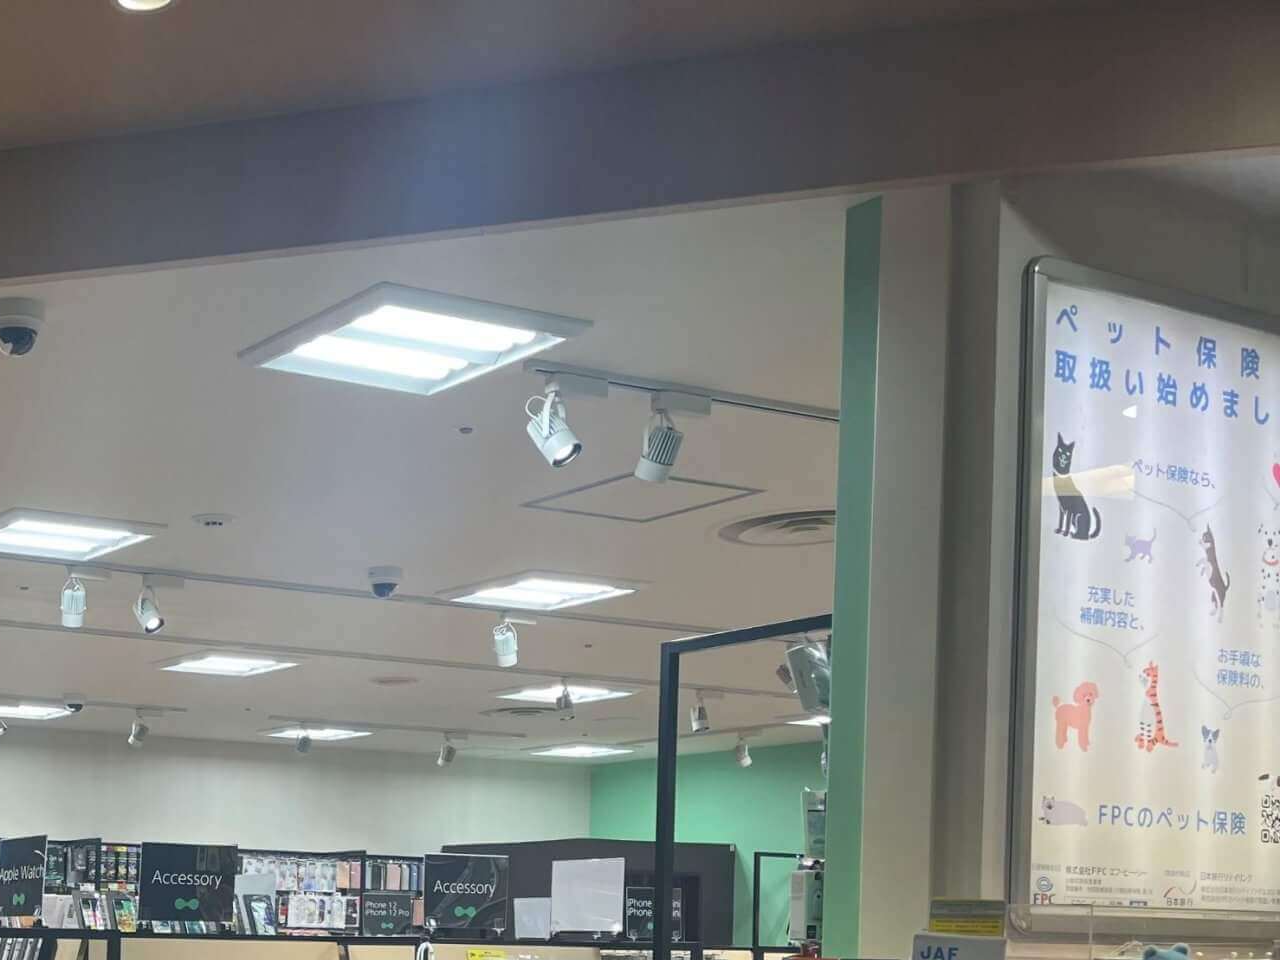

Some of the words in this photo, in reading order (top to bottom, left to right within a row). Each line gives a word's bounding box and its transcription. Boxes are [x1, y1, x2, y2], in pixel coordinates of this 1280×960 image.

[1056, 304, 1260, 379] ペット保険
[1087, 585, 1136, 608] 充実した
[1098, 805, 1247, 836] FPCのペット保険
[0, 866, 19, 882] Apple
[20, 864, 45, 880] Watch
[151, 868, 223, 888] Accessory
[433, 879, 496, 898] Accessory
[920, 945, 959, 960] JAF
